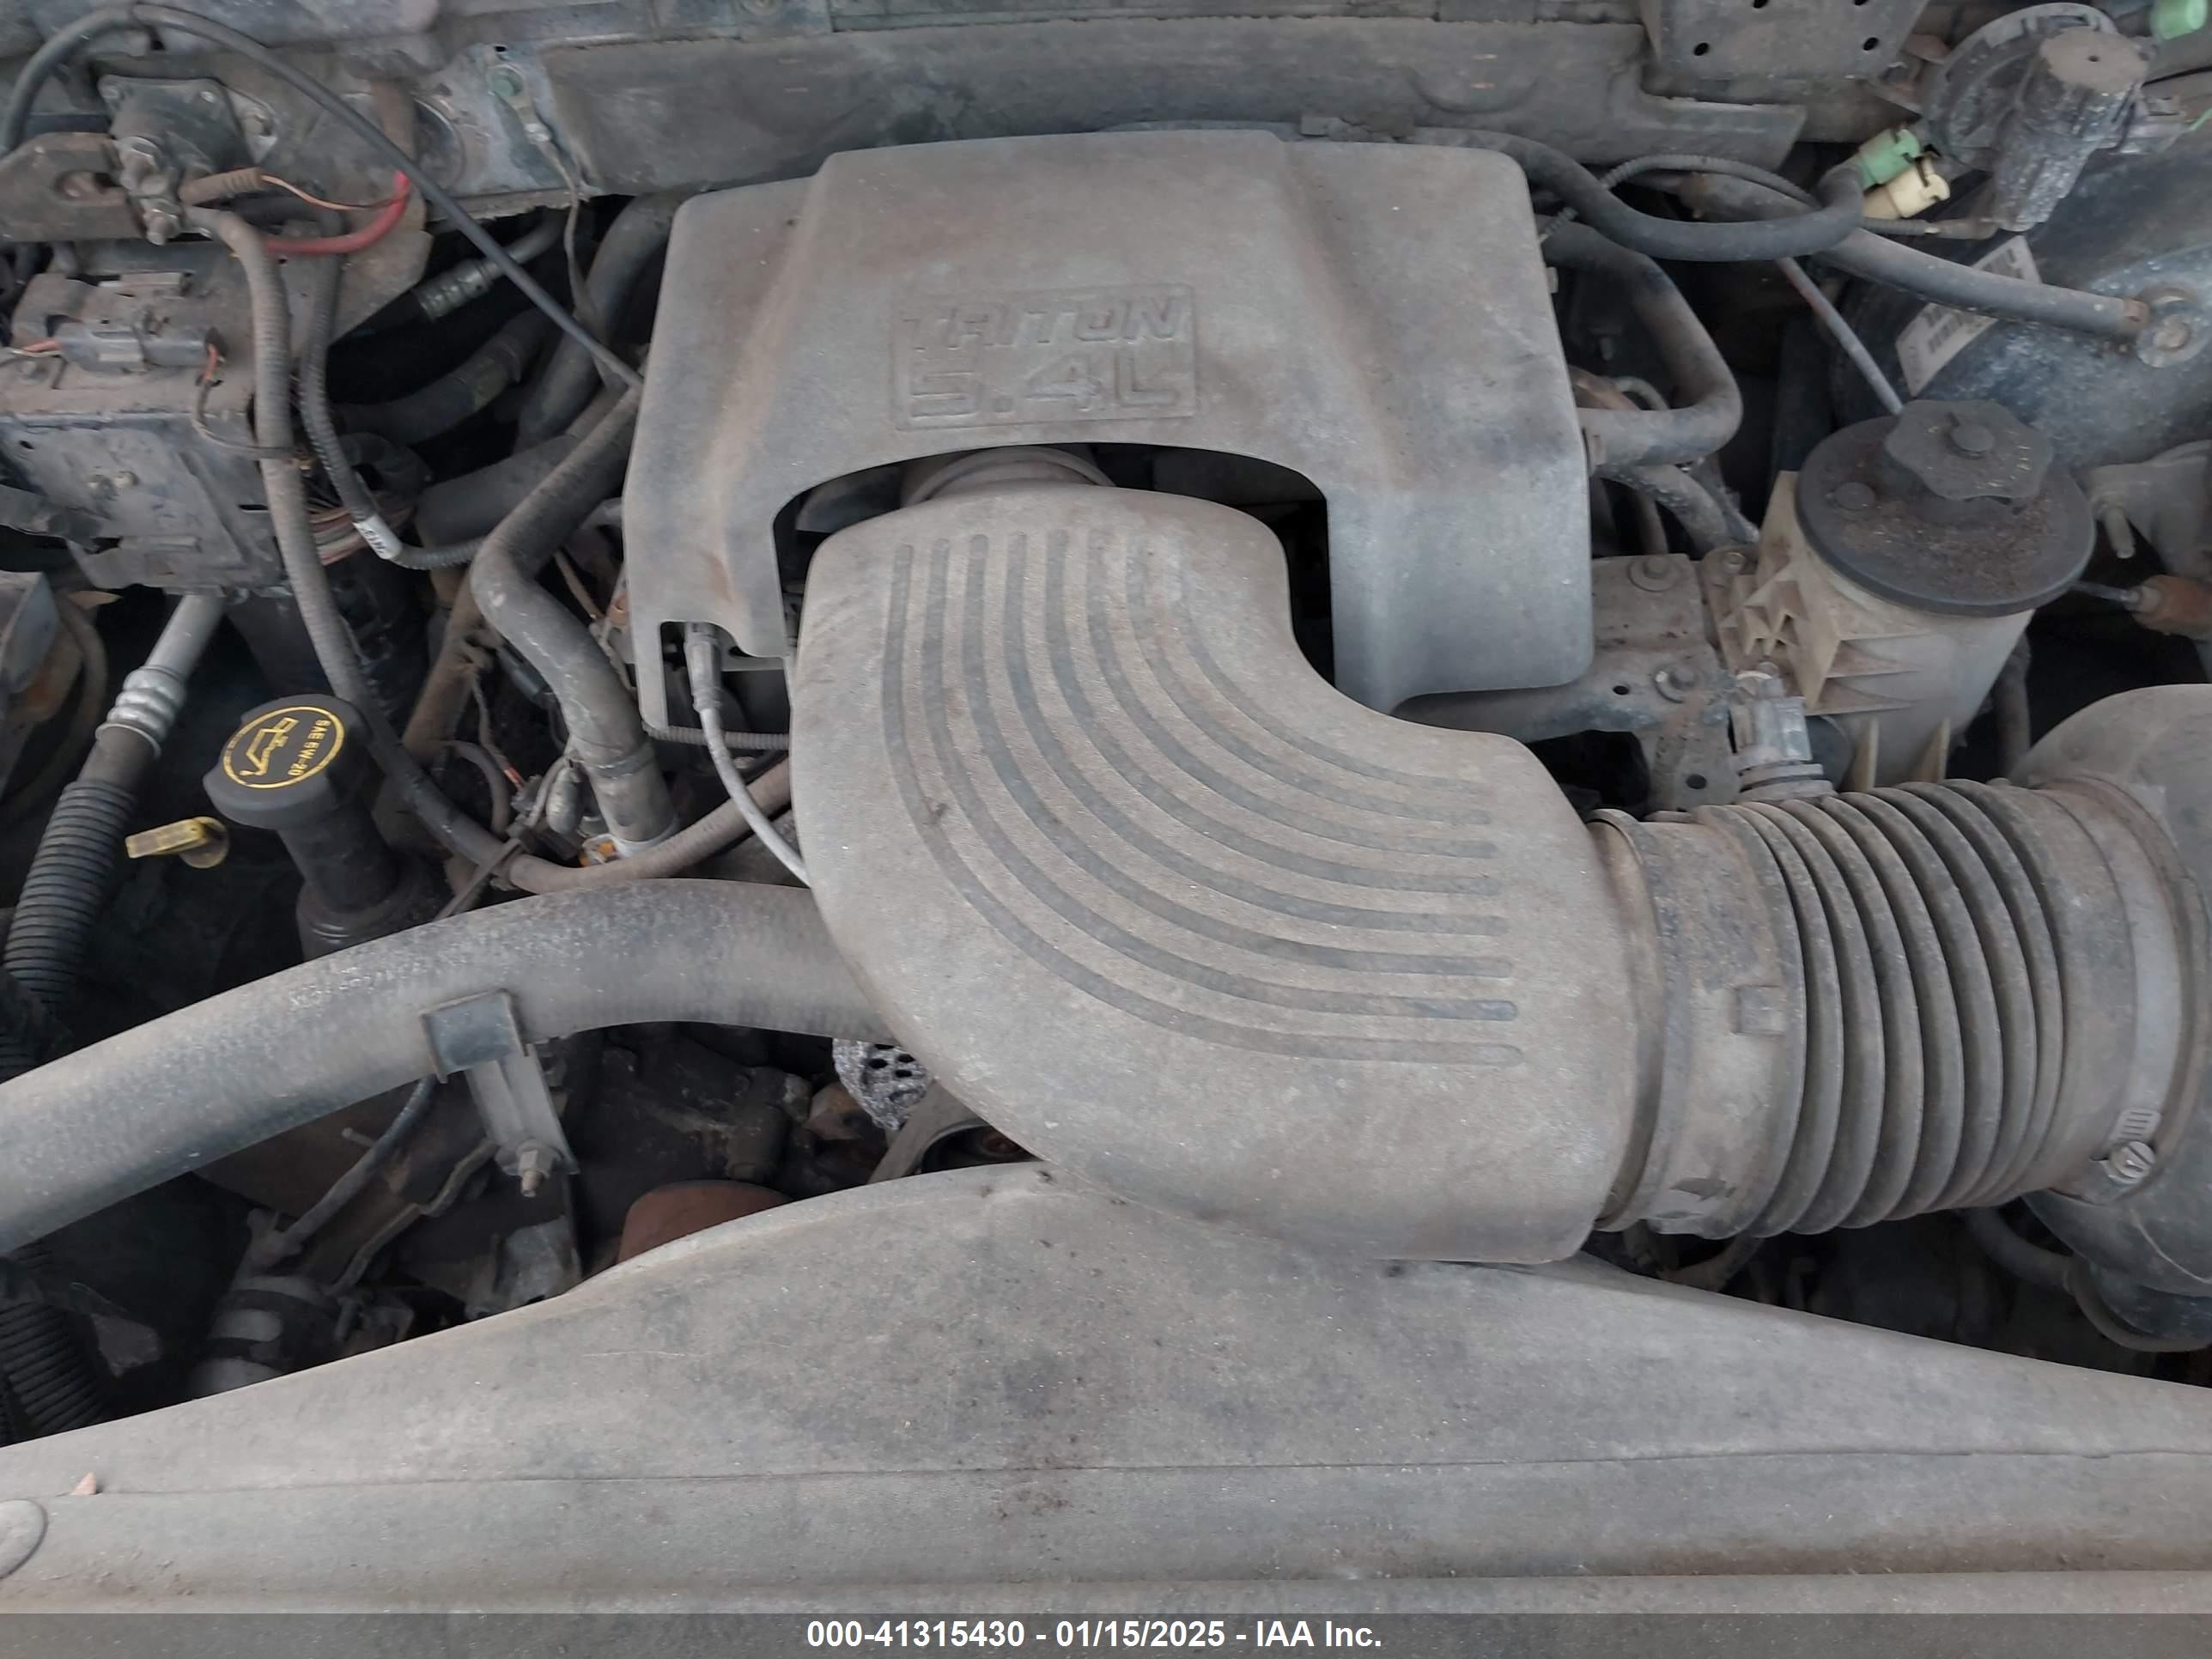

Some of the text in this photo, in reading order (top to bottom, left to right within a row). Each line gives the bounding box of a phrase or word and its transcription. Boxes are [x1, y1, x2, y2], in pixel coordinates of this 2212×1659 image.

[900, 297, 1183, 352] TRITON
[907, 345, 1180, 419] 5.4L
[288, 719, 332, 776] SAE 5W-20
